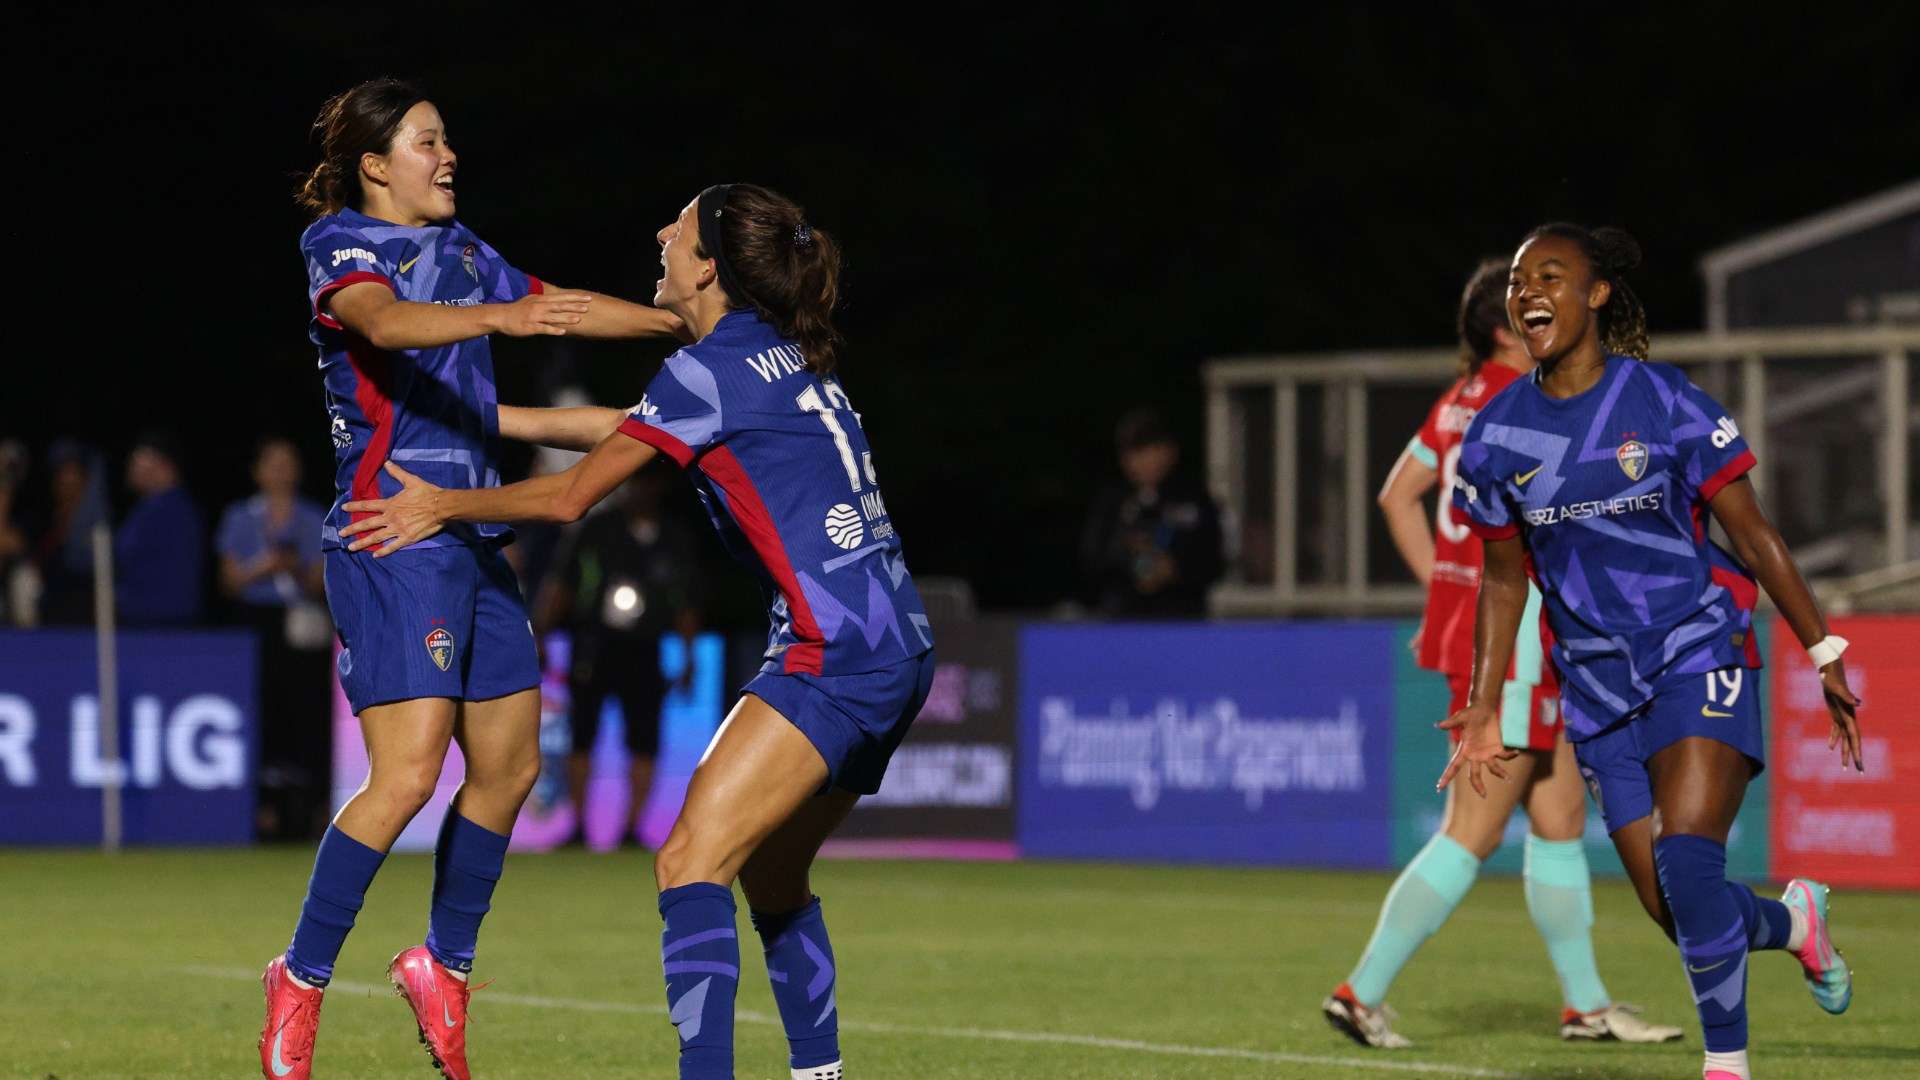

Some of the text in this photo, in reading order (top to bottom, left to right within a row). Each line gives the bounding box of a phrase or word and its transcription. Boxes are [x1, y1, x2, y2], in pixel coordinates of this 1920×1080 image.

[331, 247, 377, 267] Jump
[1559, 493, 1661, 521] AESTHETICS
[1706, 667, 1743, 708] 19
[70, 692, 248, 790] LIG
